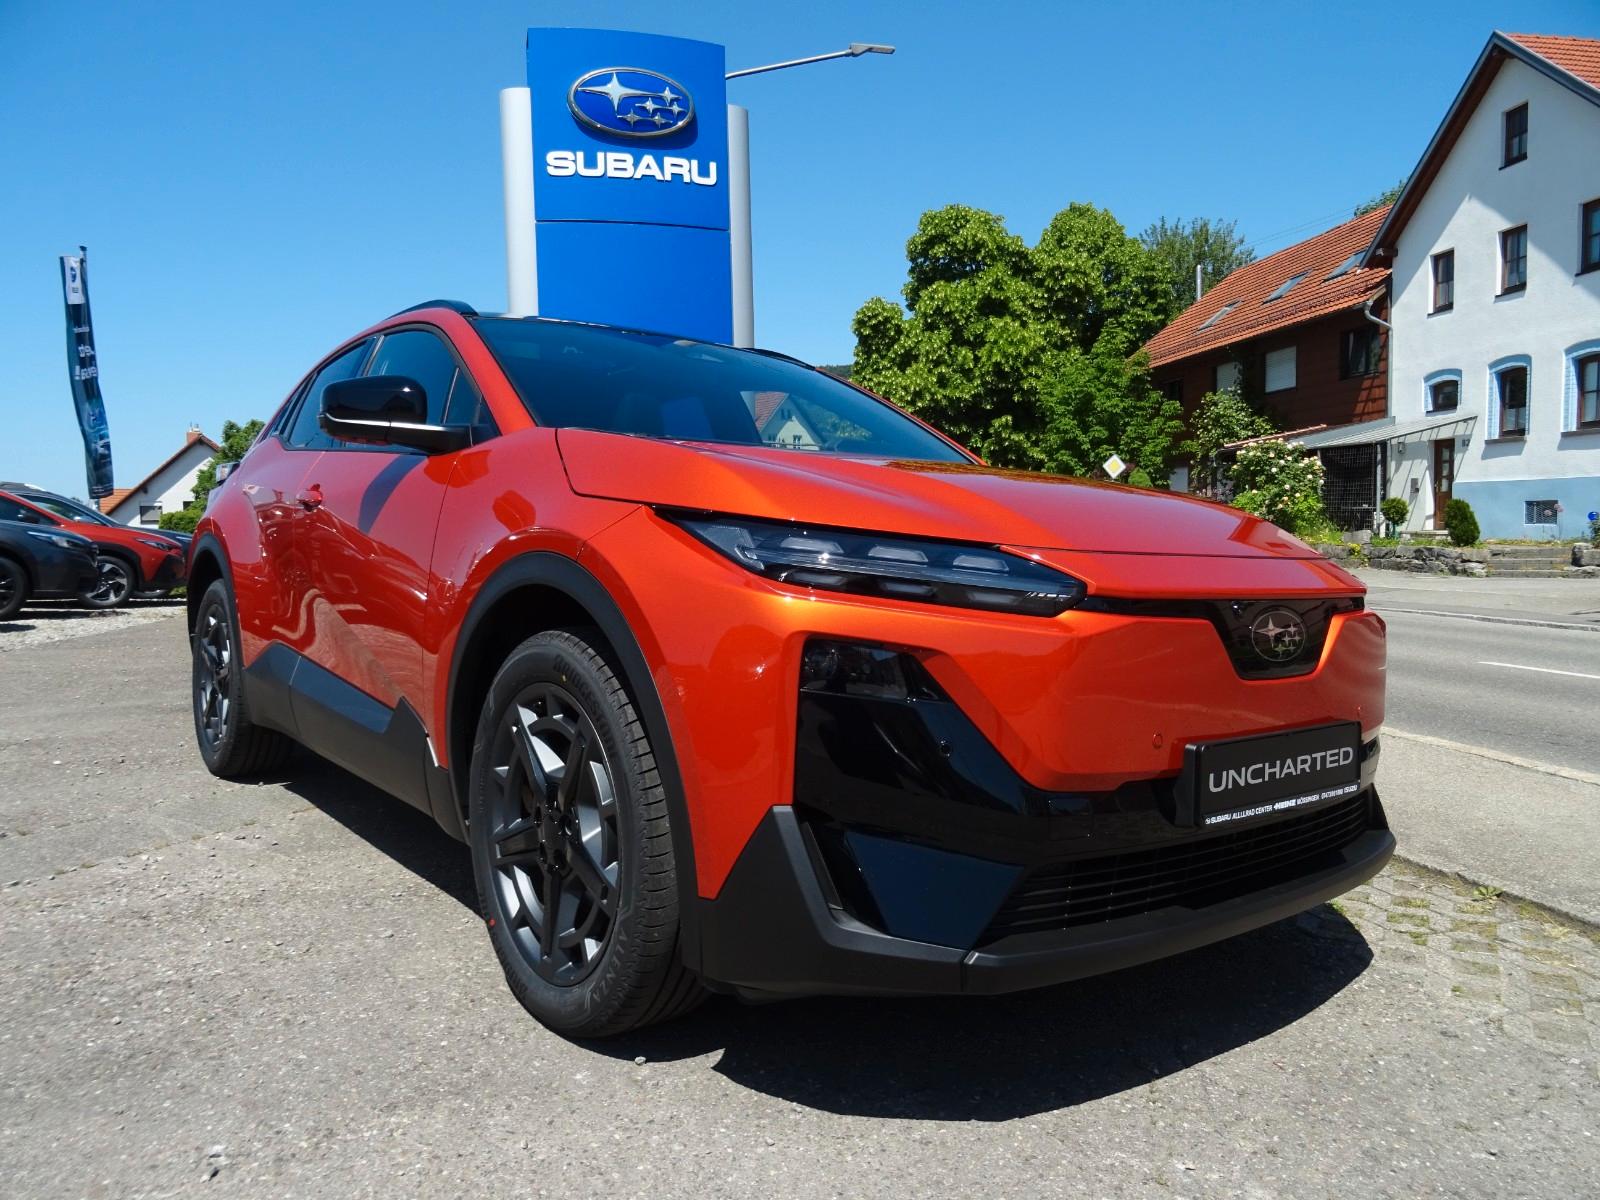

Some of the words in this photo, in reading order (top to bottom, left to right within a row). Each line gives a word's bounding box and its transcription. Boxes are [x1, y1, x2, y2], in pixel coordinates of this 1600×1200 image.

[545, 150, 717, 186] SUBARU
[1208, 746, 1354, 793] UNCHARTED
[1210, 812, 1232, 824] SUBARU
[1255, 804, 1273, 815] CENTER
